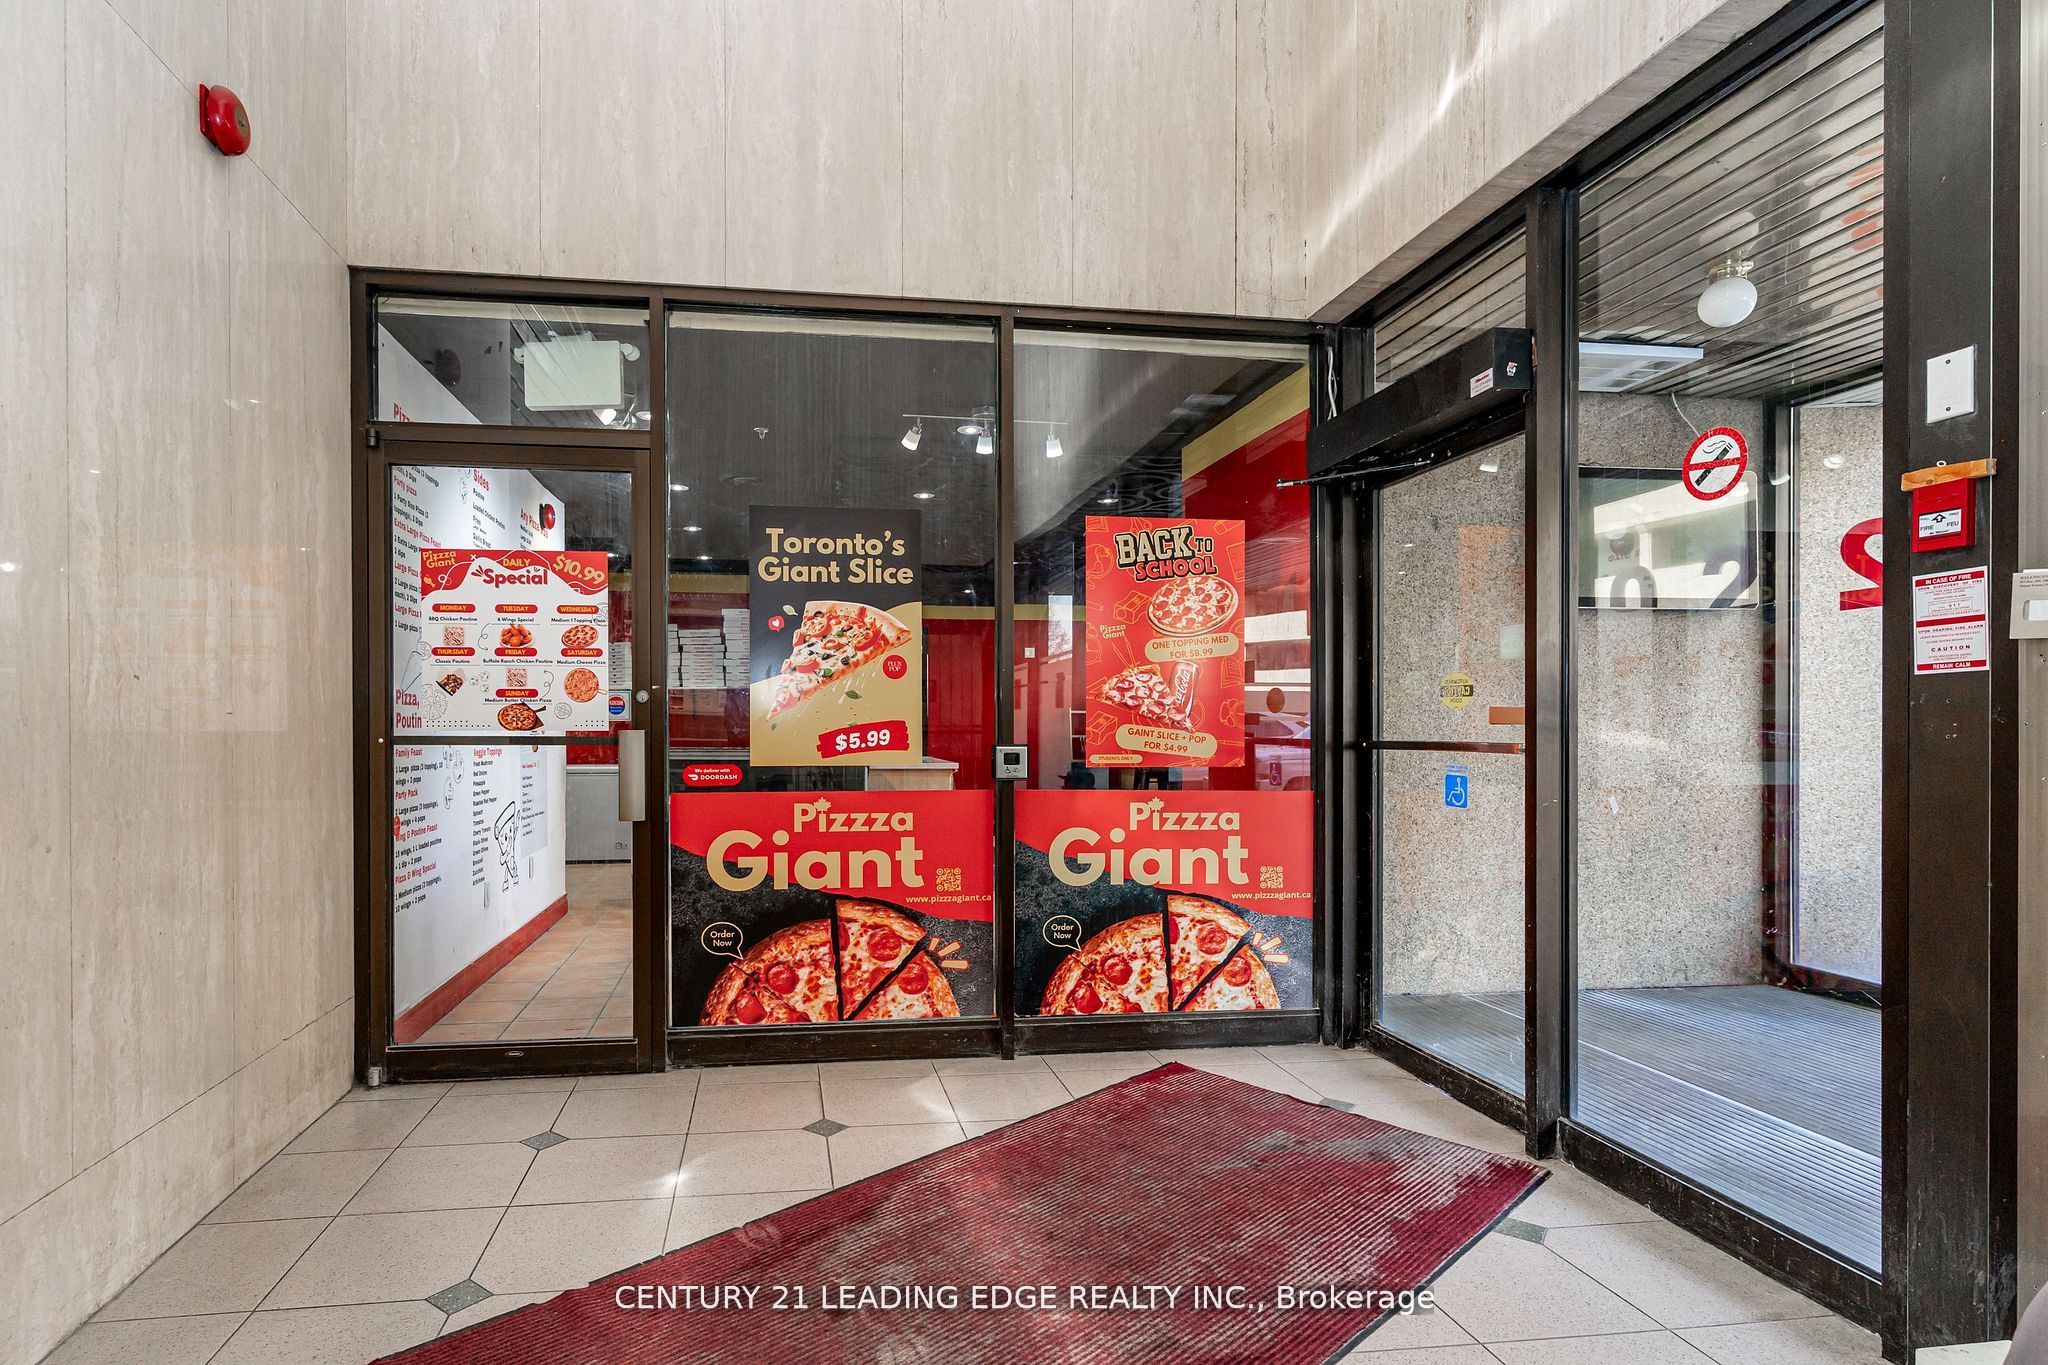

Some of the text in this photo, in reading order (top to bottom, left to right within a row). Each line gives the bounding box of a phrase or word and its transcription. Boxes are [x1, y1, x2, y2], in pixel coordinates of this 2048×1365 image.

[473, 468, 490, 492] Sides
[1920, 524, 1934, 532] FIRE
[765, 527, 905, 556] Toronto's
[1115, 527, 1213, 567] BACK TO
[502, 558, 531, 568] DAILY
[553, 553, 606, 585] $10.99
[757, 556, 915, 585] Giant Slice
[1135, 555, 1218, 580] SCHOOL
[482, 567, 549, 589] Special
[1932, 576, 1949, 584] CASE
[1958, 573, 1972, 581] FIRE
[1152, 635, 1229, 650] ONE TOPPING MED
[1931, 644, 1971, 652] CAUTION
[1170, 648, 1213, 659] FOR $8.99
[395, 711, 423, 730] Poutin
[835, 729, 891, 751] $5.99
[1127, 727, 1156, 738] GAINT
[1156, 731, 1181, 742] SLICE
[1188, 735, 1207, 744] POP
[1143, 740, 1188, 753] FOR $4.99
[793, 801, 914, 833] Pizzza
[1130, 802, 1240, 831] Pizzza
[706, 829, 926, 892] Giant
[1048, 827, 1250, 887] Giant
[905, 894, 992, 904] www.pizzzagiant.ca
[1231, 891, 1312, 901] www.pizzzagiant.ca
[710, 929, 735, 938] Order
[1051, 922, 1075, 931] Order
[713, 939, 733, 947] Now
